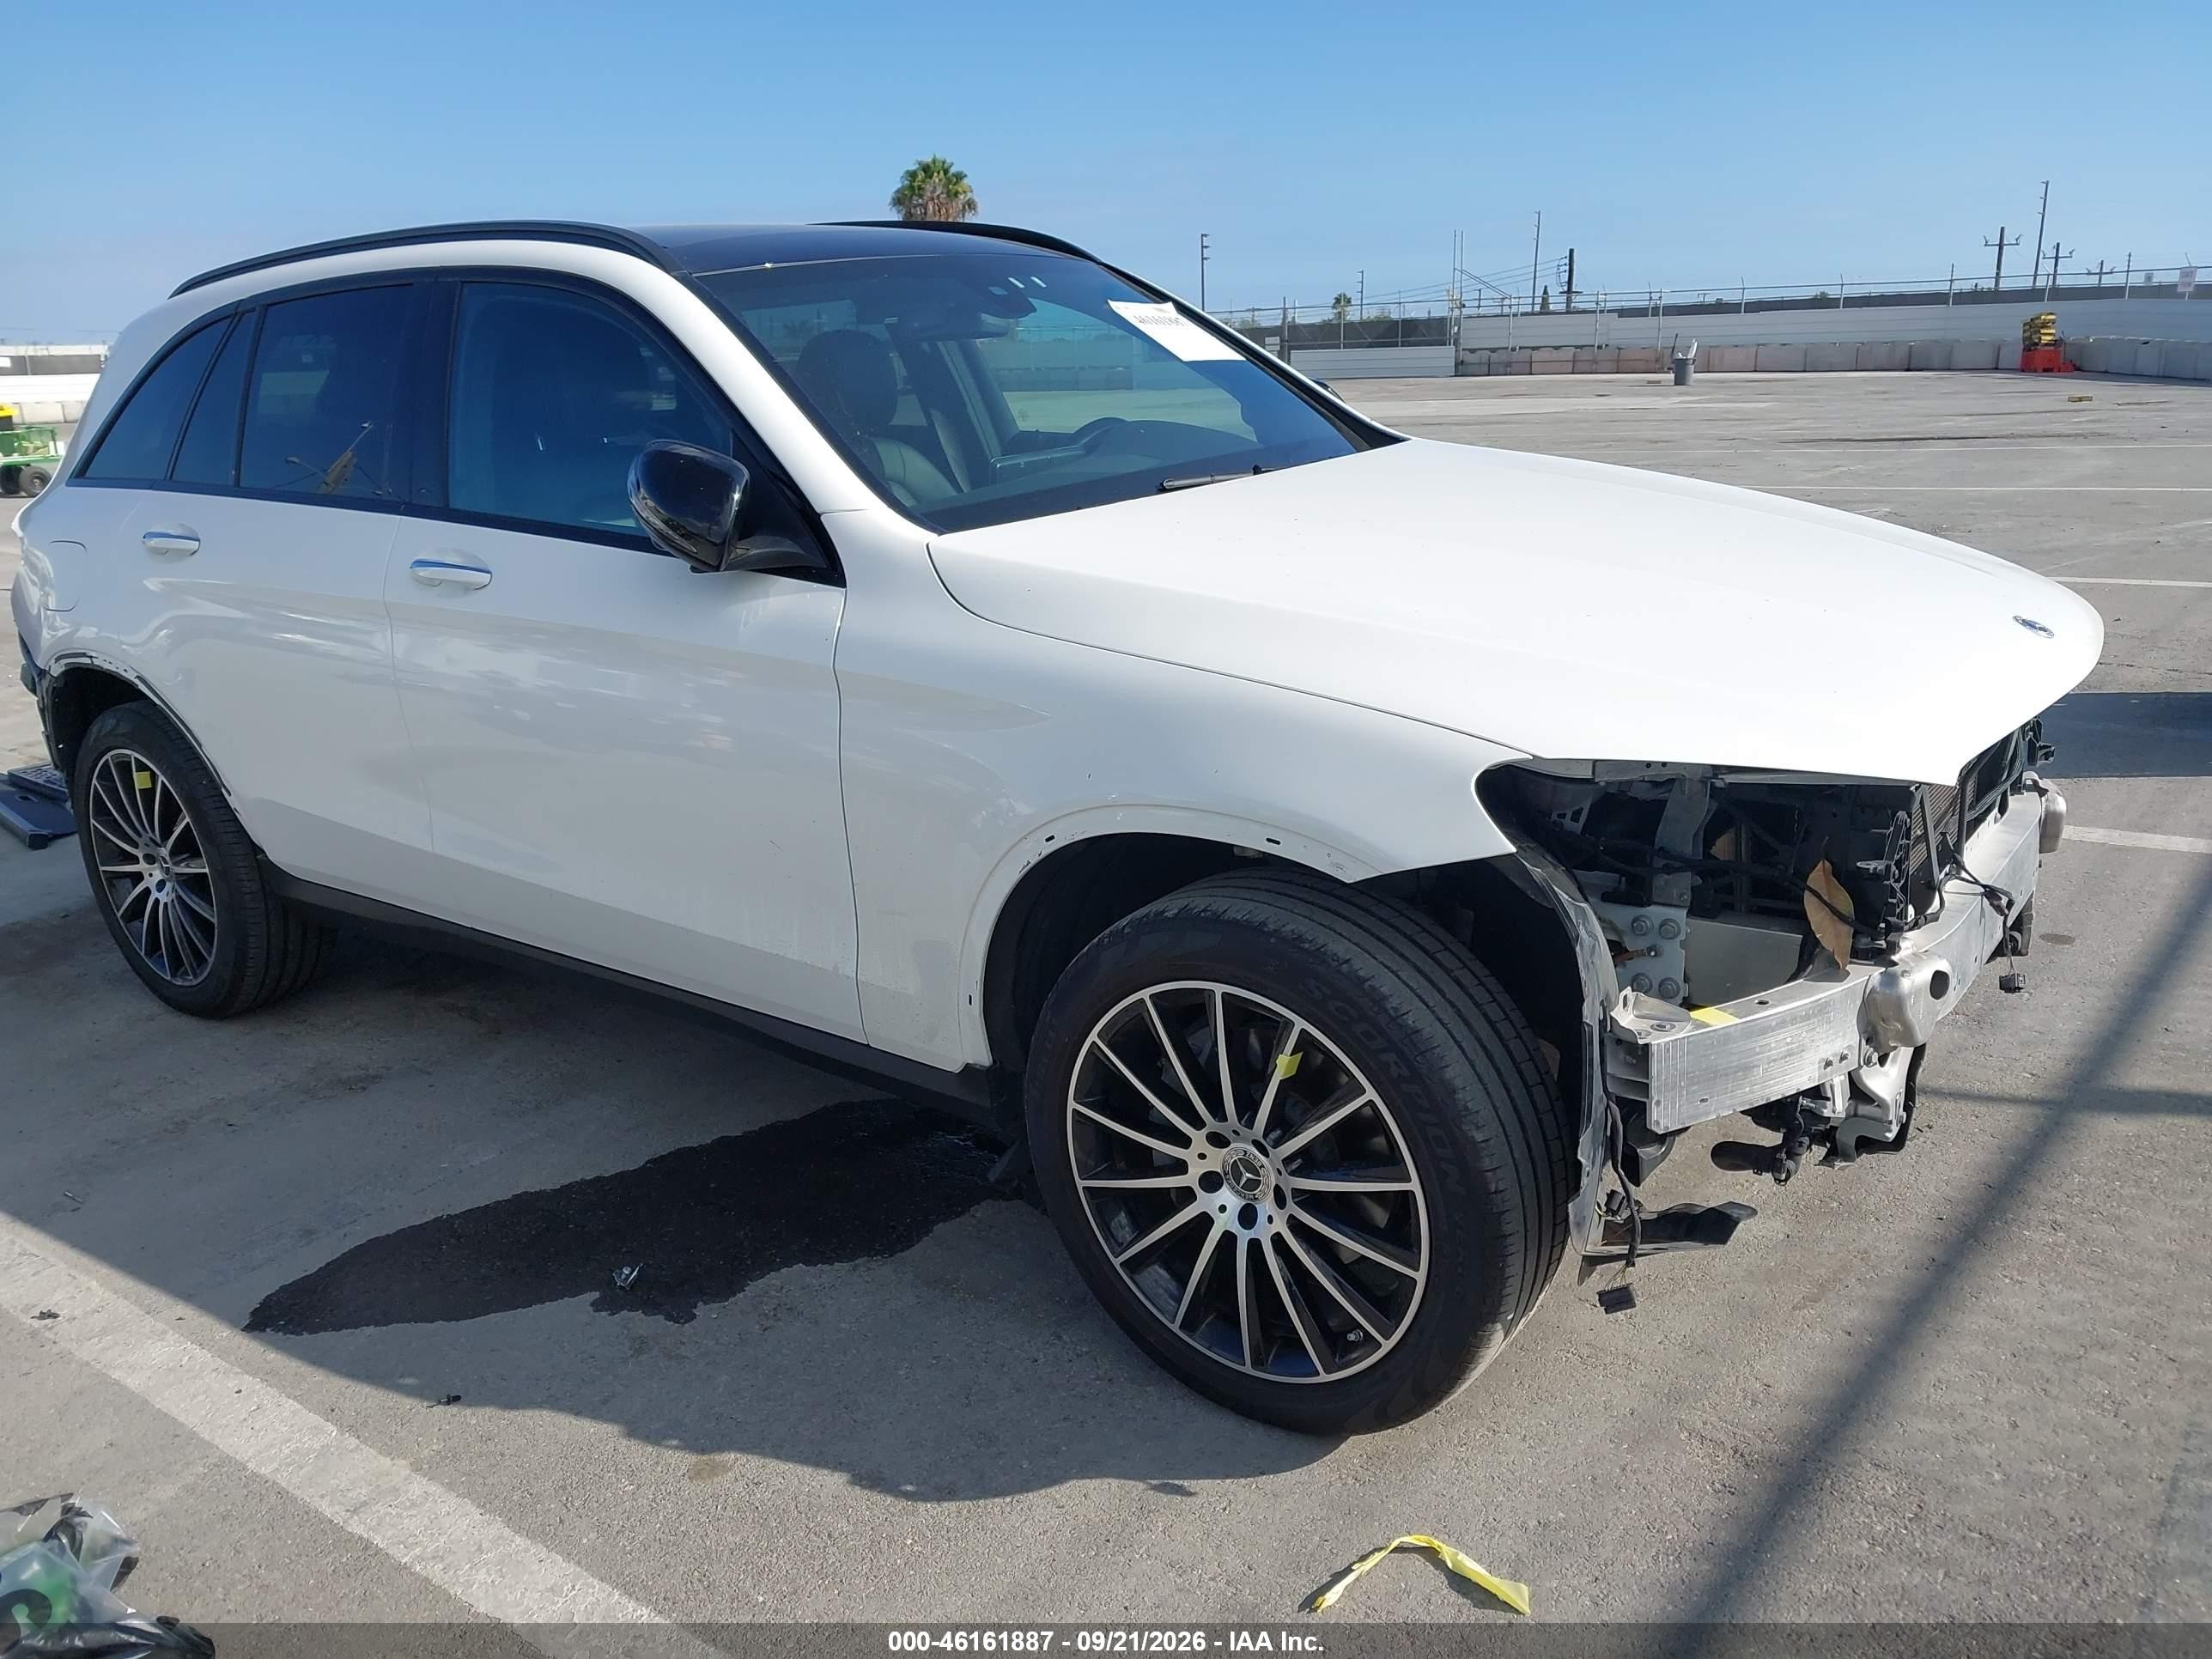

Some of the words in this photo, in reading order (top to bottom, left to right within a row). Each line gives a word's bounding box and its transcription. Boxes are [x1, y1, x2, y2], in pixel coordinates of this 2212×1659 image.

[1298, 975, 1468, 1197] SCORPION
[1245, 1152, 1262, 1167] BENZ
[1224, 1175, 1255, 1200] MERCEDES
